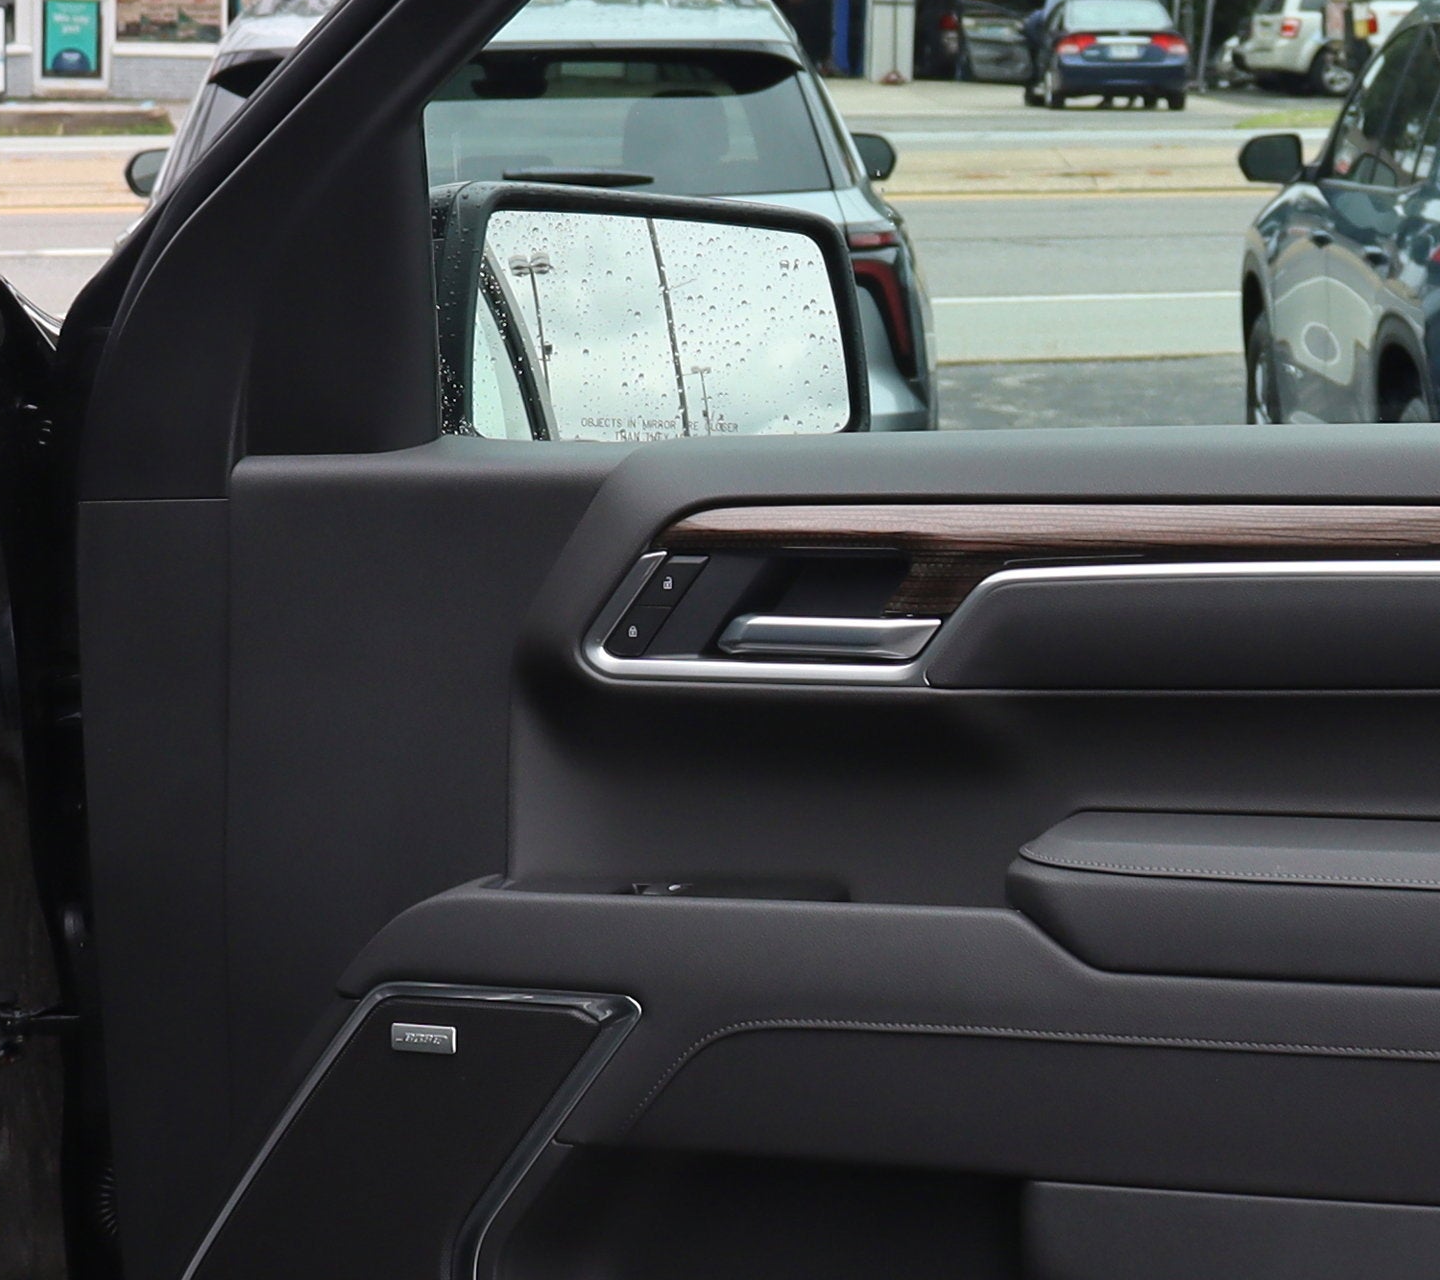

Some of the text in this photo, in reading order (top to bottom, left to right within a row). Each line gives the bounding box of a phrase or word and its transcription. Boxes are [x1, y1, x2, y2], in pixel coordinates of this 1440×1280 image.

[580, 417, 622, 428] OBJECTS
[626, 419, 637, 428] IN
[642, 419, 676, 430] MIRROR
